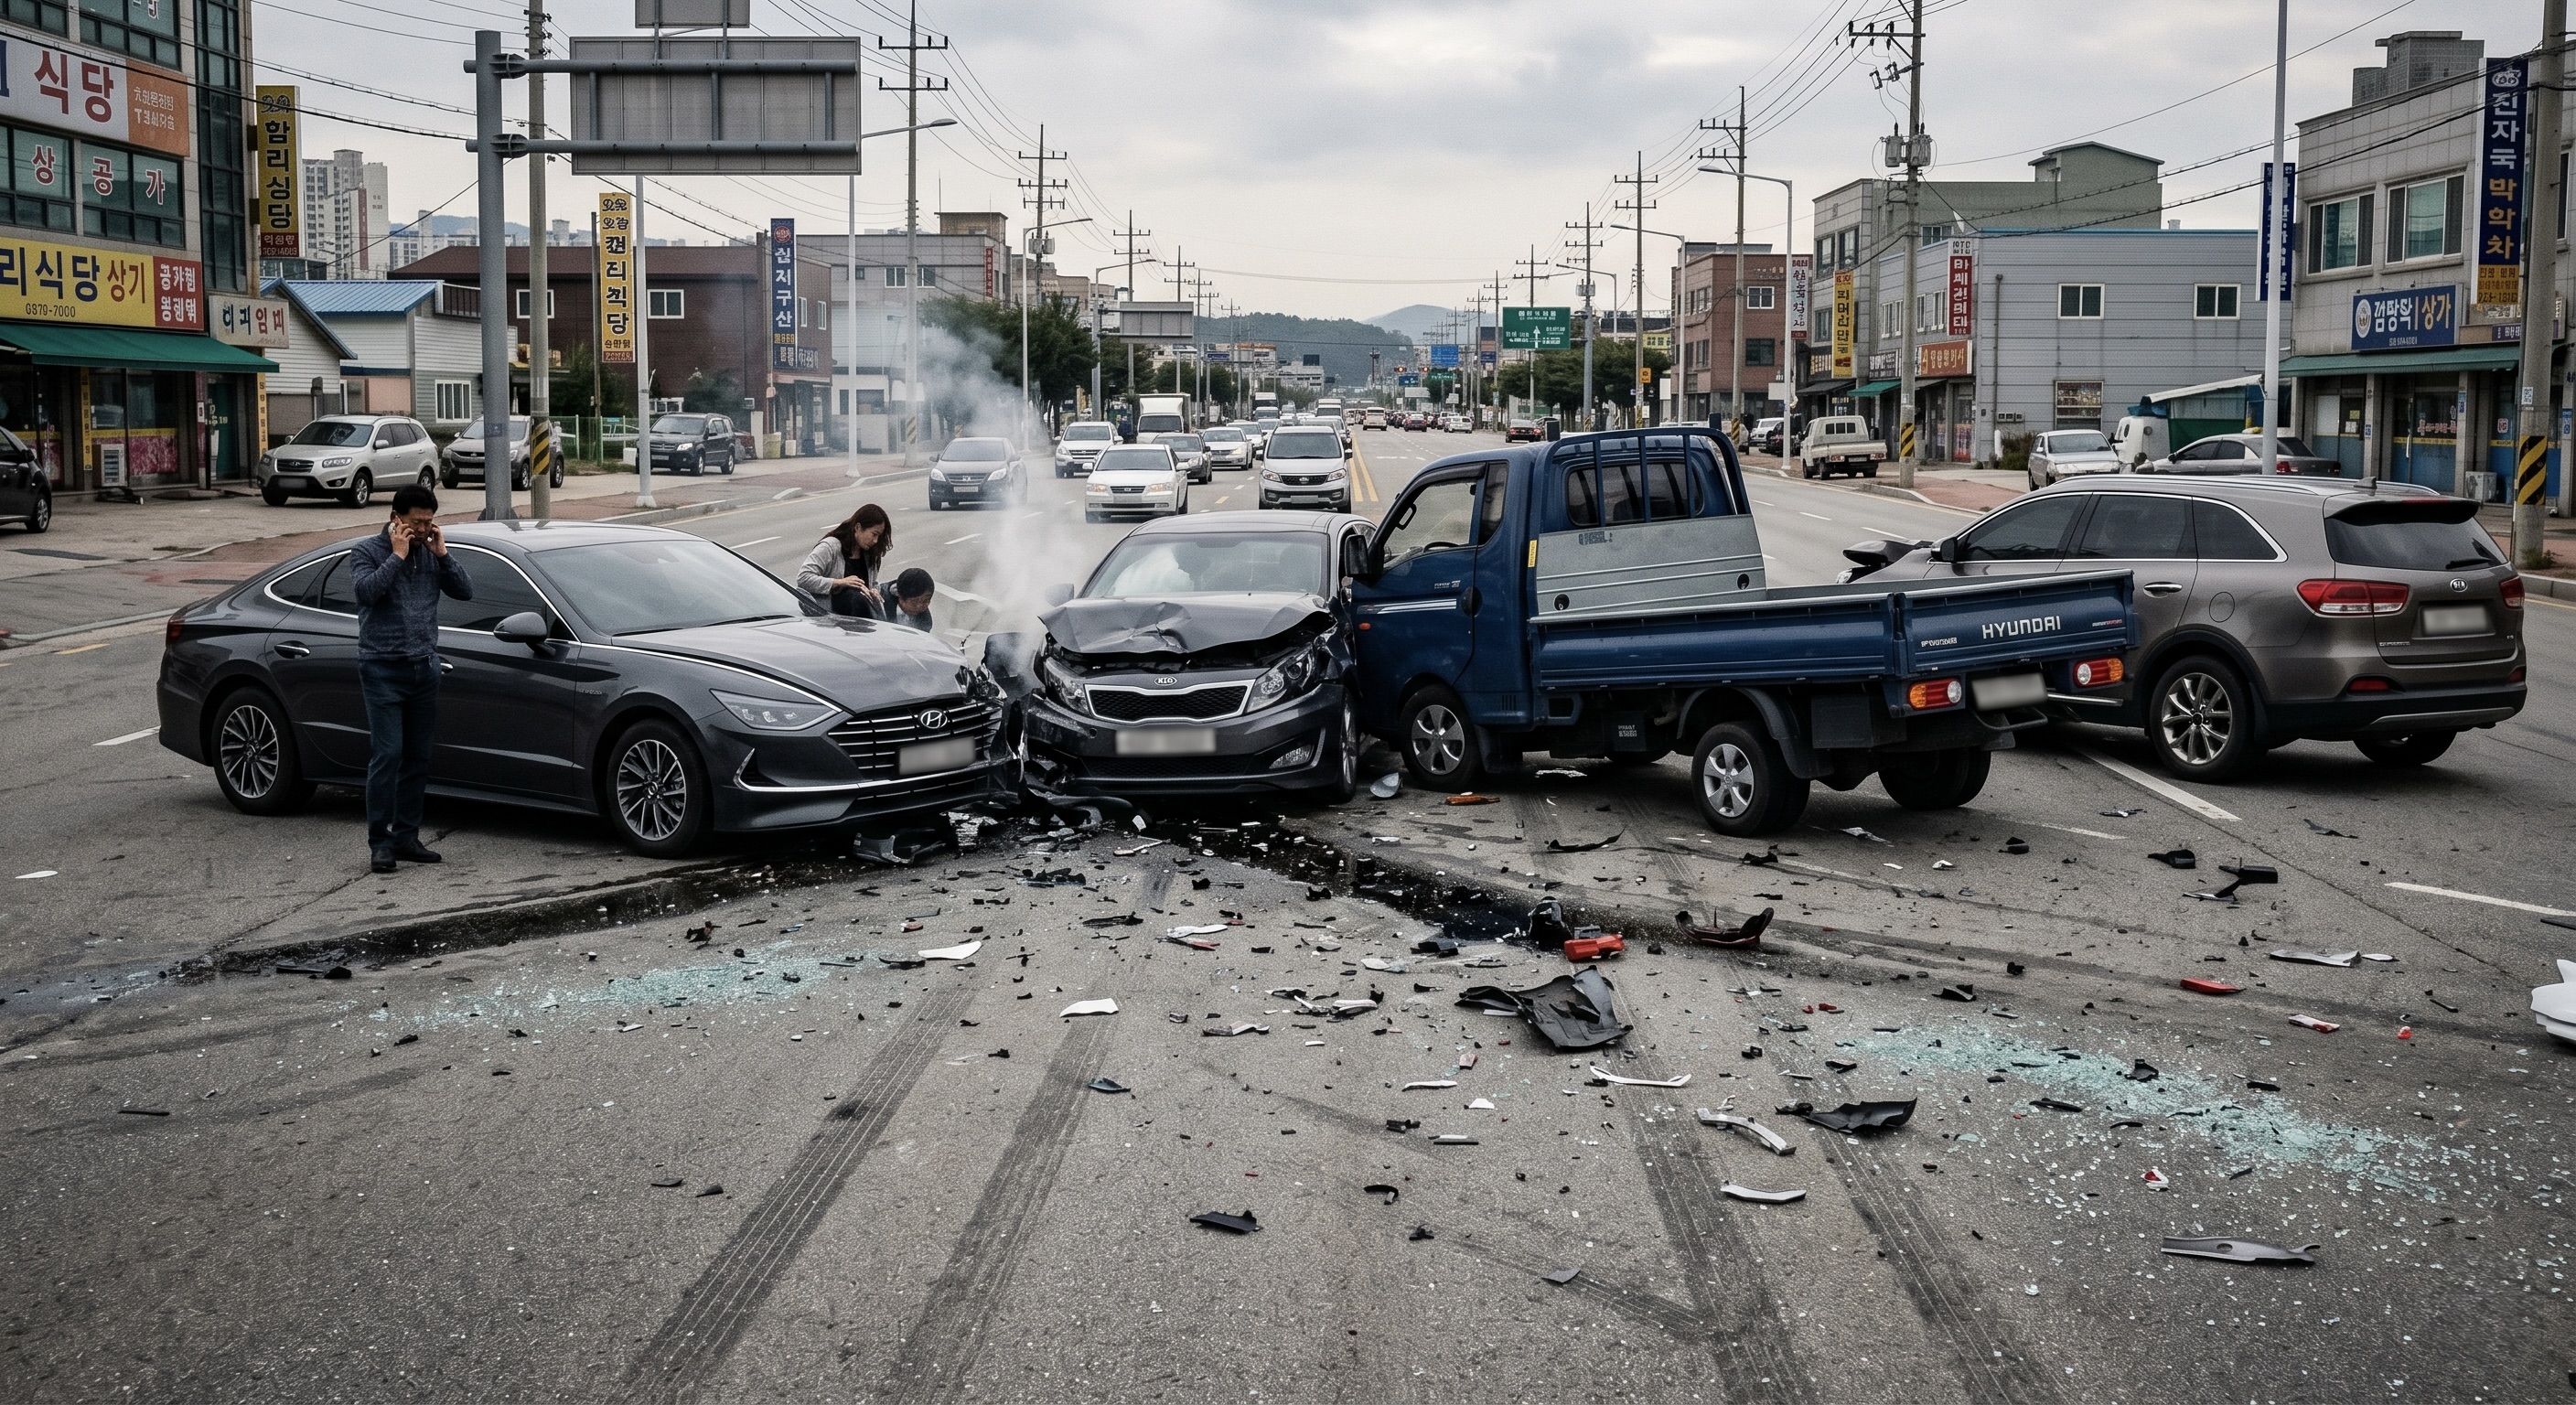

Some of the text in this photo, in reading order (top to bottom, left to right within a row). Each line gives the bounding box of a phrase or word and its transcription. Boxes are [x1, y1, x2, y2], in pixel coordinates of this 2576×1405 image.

[34, 50, 114, 123] 식당
[2421, 293, 2452, 330] 상가
[1981, 616, 2061, 638] HYUNDAI
